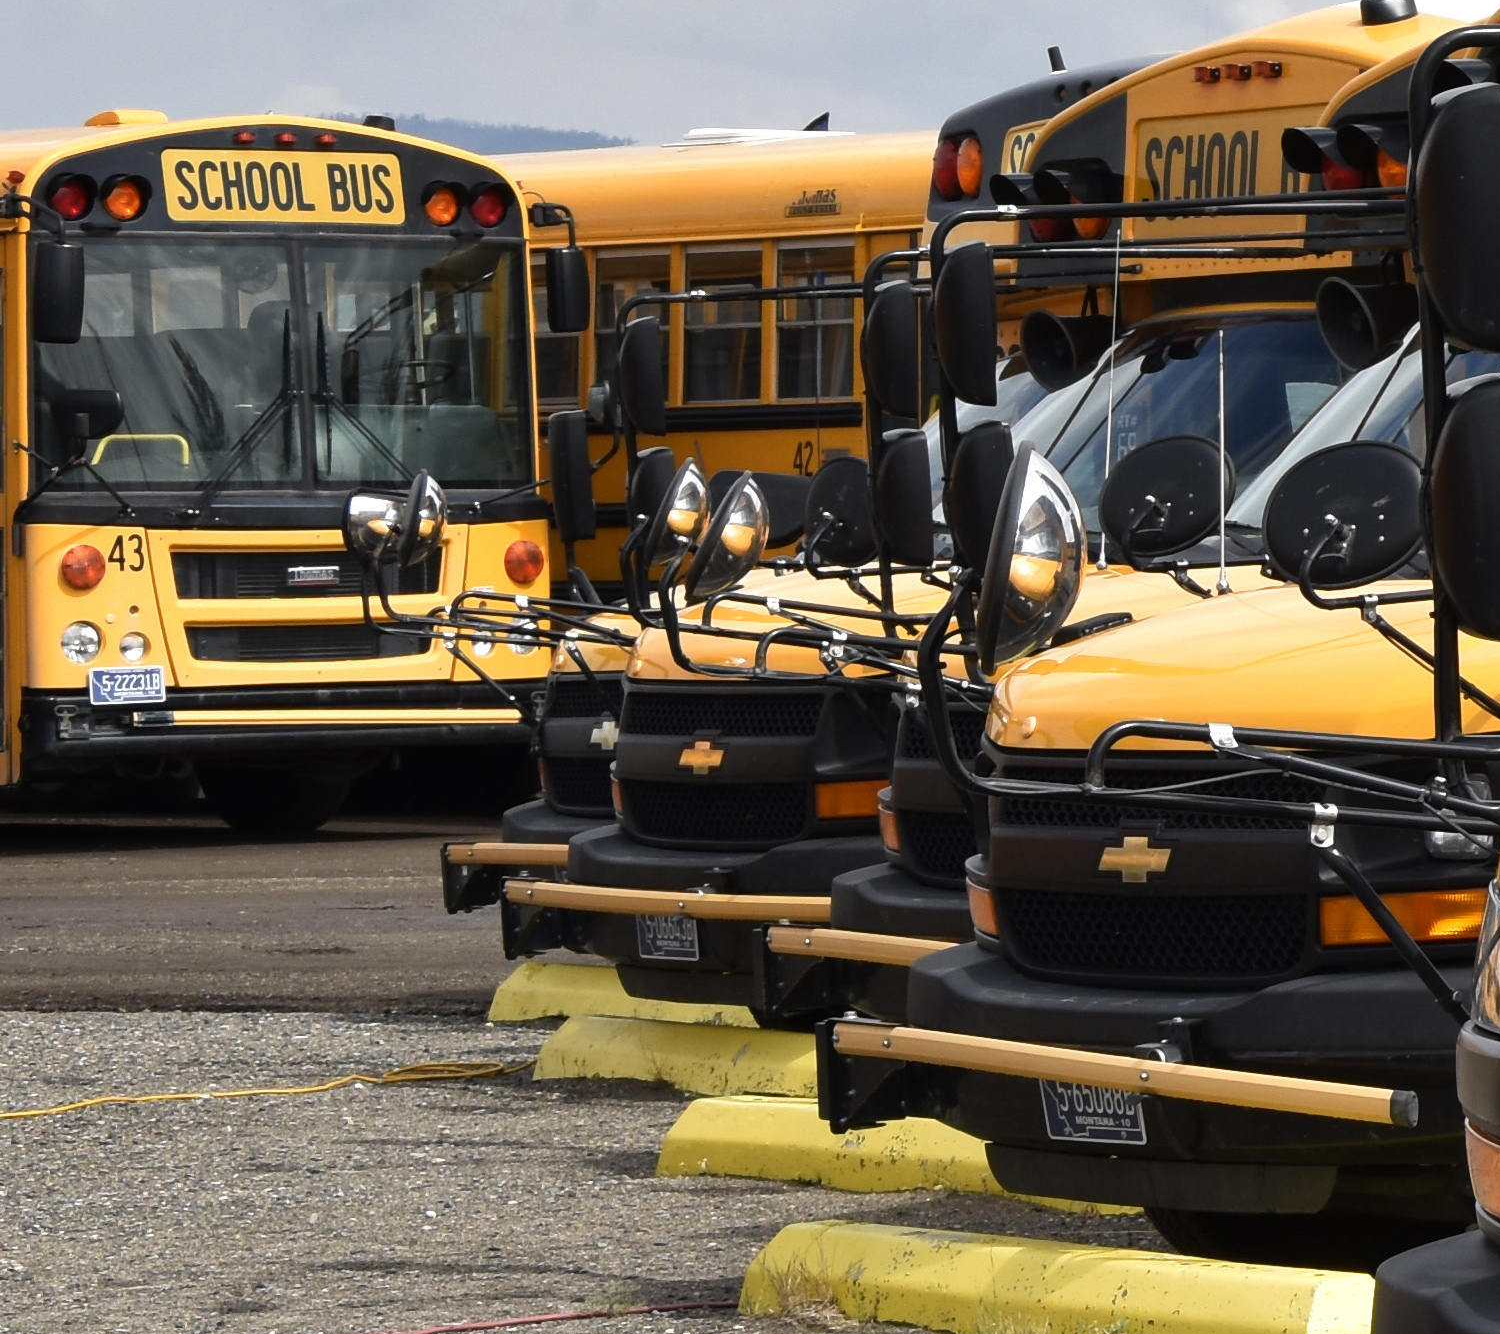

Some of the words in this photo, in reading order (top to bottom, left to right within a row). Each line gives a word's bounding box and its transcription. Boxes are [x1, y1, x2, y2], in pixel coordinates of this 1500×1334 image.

[174, 160, 317, 212] SCHOOL
[326, 163, 396, 214] BUS
[793, 440, 814, 476] 42
[107, 533, 145, 572] 43
